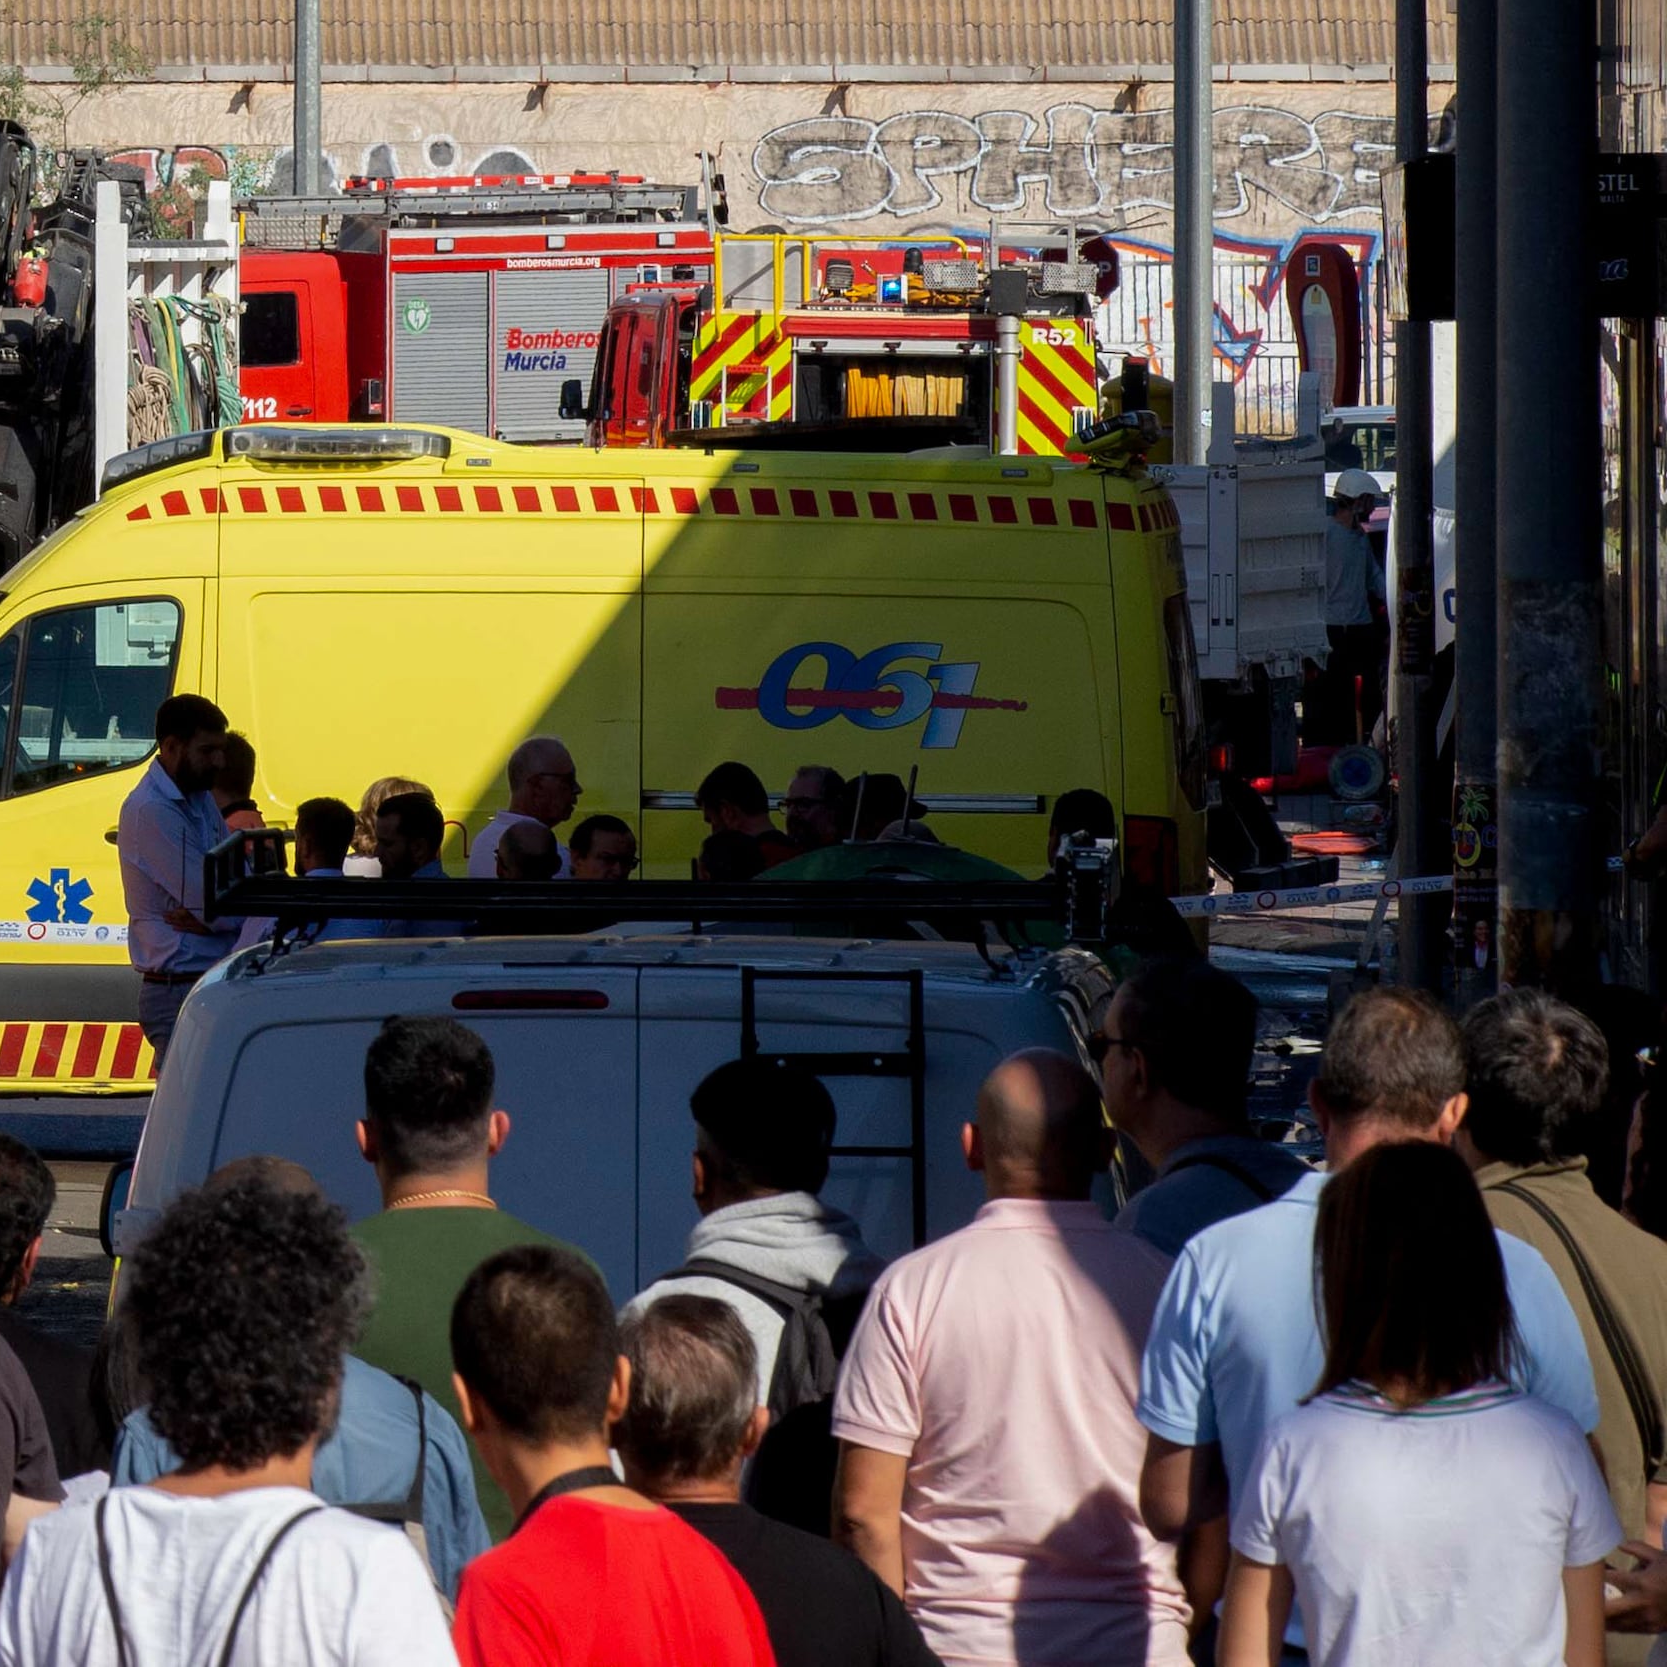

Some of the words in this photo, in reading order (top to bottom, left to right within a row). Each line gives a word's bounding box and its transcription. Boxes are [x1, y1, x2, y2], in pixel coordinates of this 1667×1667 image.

[506, 257, 601, 269] bomberosmurcia.org
[1031, 328, 1076, 346] R52
[504, 351, 566, 371] Murcia
[245, 397, 277, 419] 112
[757, 642, 980, 749] 061
[56, 929, 87, 937] ALTO
